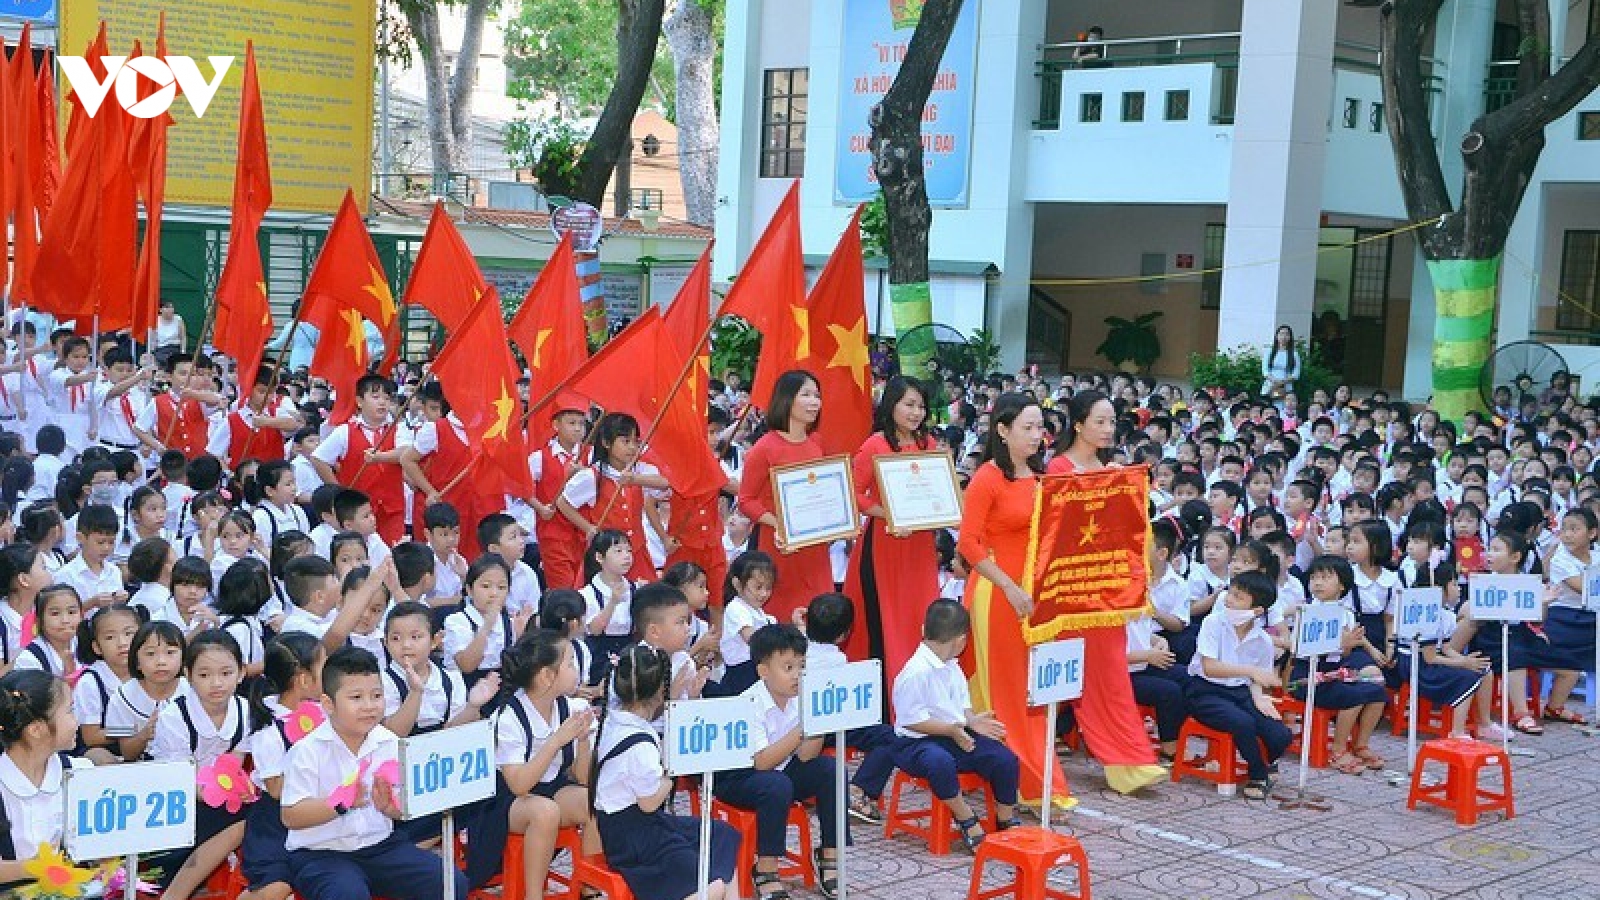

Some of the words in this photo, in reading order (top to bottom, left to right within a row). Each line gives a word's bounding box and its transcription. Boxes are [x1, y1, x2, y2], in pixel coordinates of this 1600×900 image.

[1403, 599, 1423, 625] LỚP
[1425, 602, 1438, 624] 1C
[1475, 585, 1508, 609] LỚP
[1513, 589, 1535, 609] 1B
[1302, 617, 1324, 643] LỚP
[1325, 619, 1339, 640] 1D
[1037, 657, 1061, 689] LỚP
[1063, 658, 1079, 685] 1E
[812, 679, 849, 717] LỚP
[853, 682, 873, 709] 1F
[678, 713, 718, 755] LỚP
[723, 719, 749, 750] 1G
[413, 752, 453, 797] LỚP
[460, 747, 490, 784] 2A
[77, 787, 138, 836] LỚP
[145, 789, 187, 829] 2B
